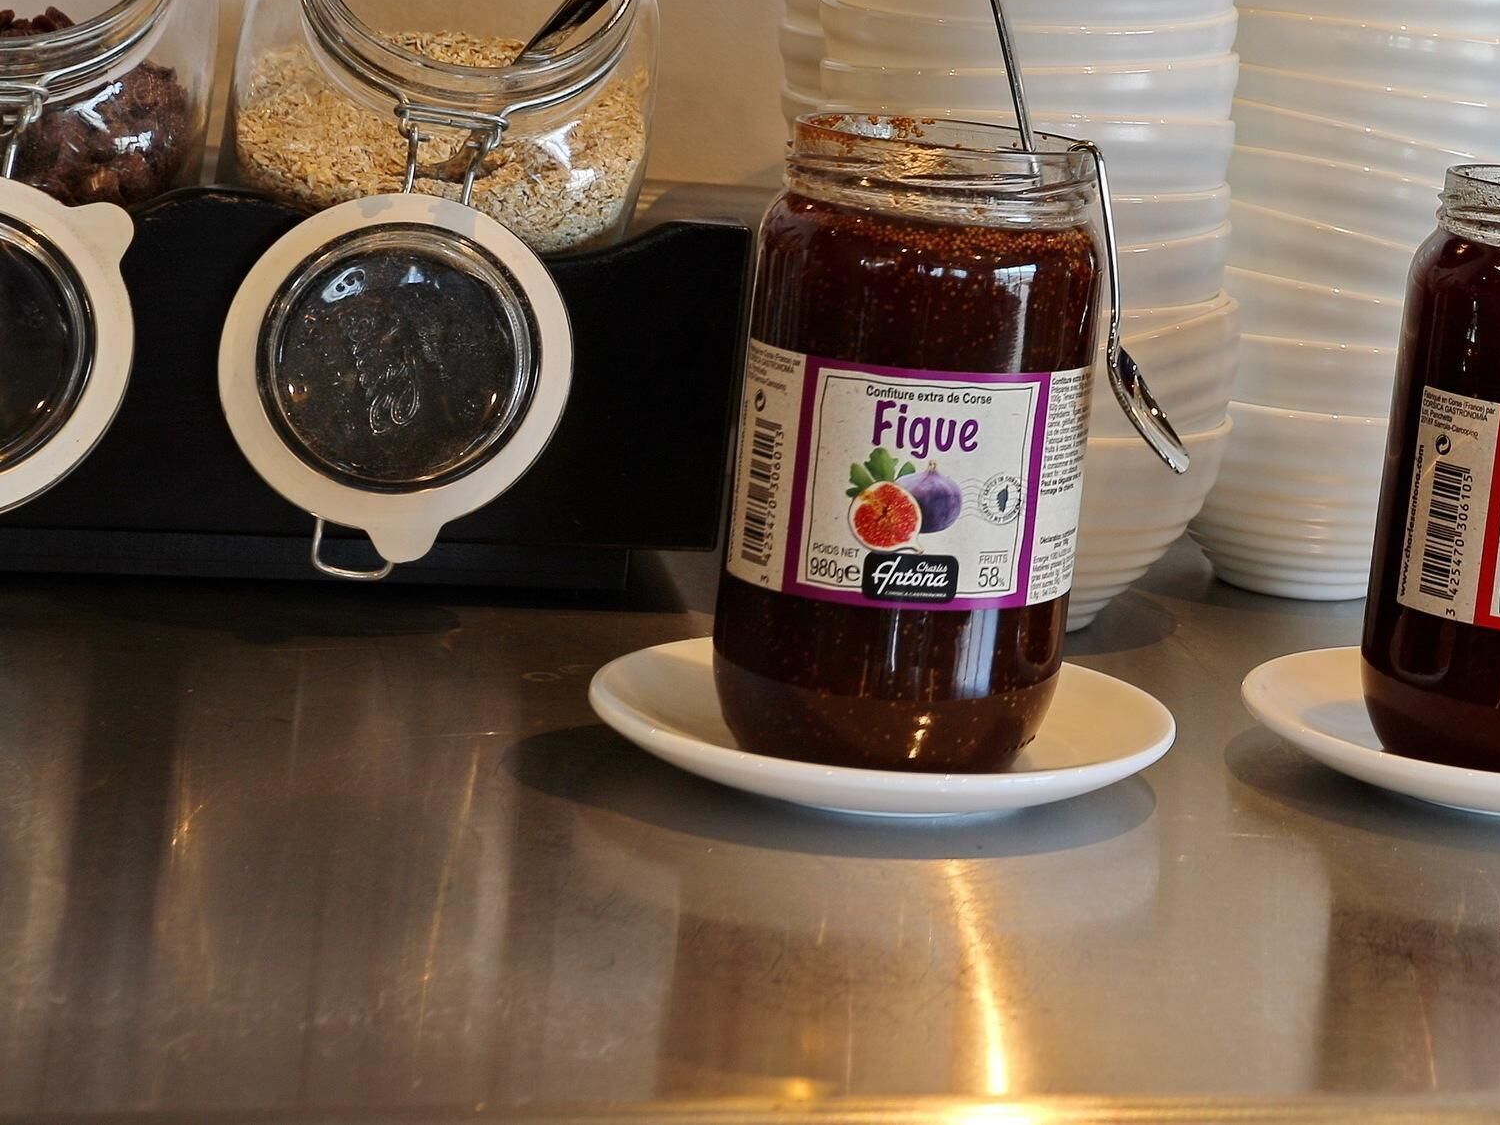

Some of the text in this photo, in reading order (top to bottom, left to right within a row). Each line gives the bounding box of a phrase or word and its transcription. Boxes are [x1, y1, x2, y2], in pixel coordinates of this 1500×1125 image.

[866, 384, 993, 404] Confiture extra de Corse
[1423, 398, 1488, 421] CORSICA GASTRONOMIA
[872, 400, 979, 459] Figue
[1457, 473, 1473, 530] 306105
[1401, 444, 1425, 596] www.charlesantona.com
[812, 542, 860, 558] POIDS NET
[979, 554, 1008, 565] FRUITS
[872, 556, 948, 595] Antona
[916, 561, 948, 573] Charles
[1449, 539, 1465, 596] 425470
[759, 575, 770, 584] 3
[1446, 608, 1456, 617] 3
